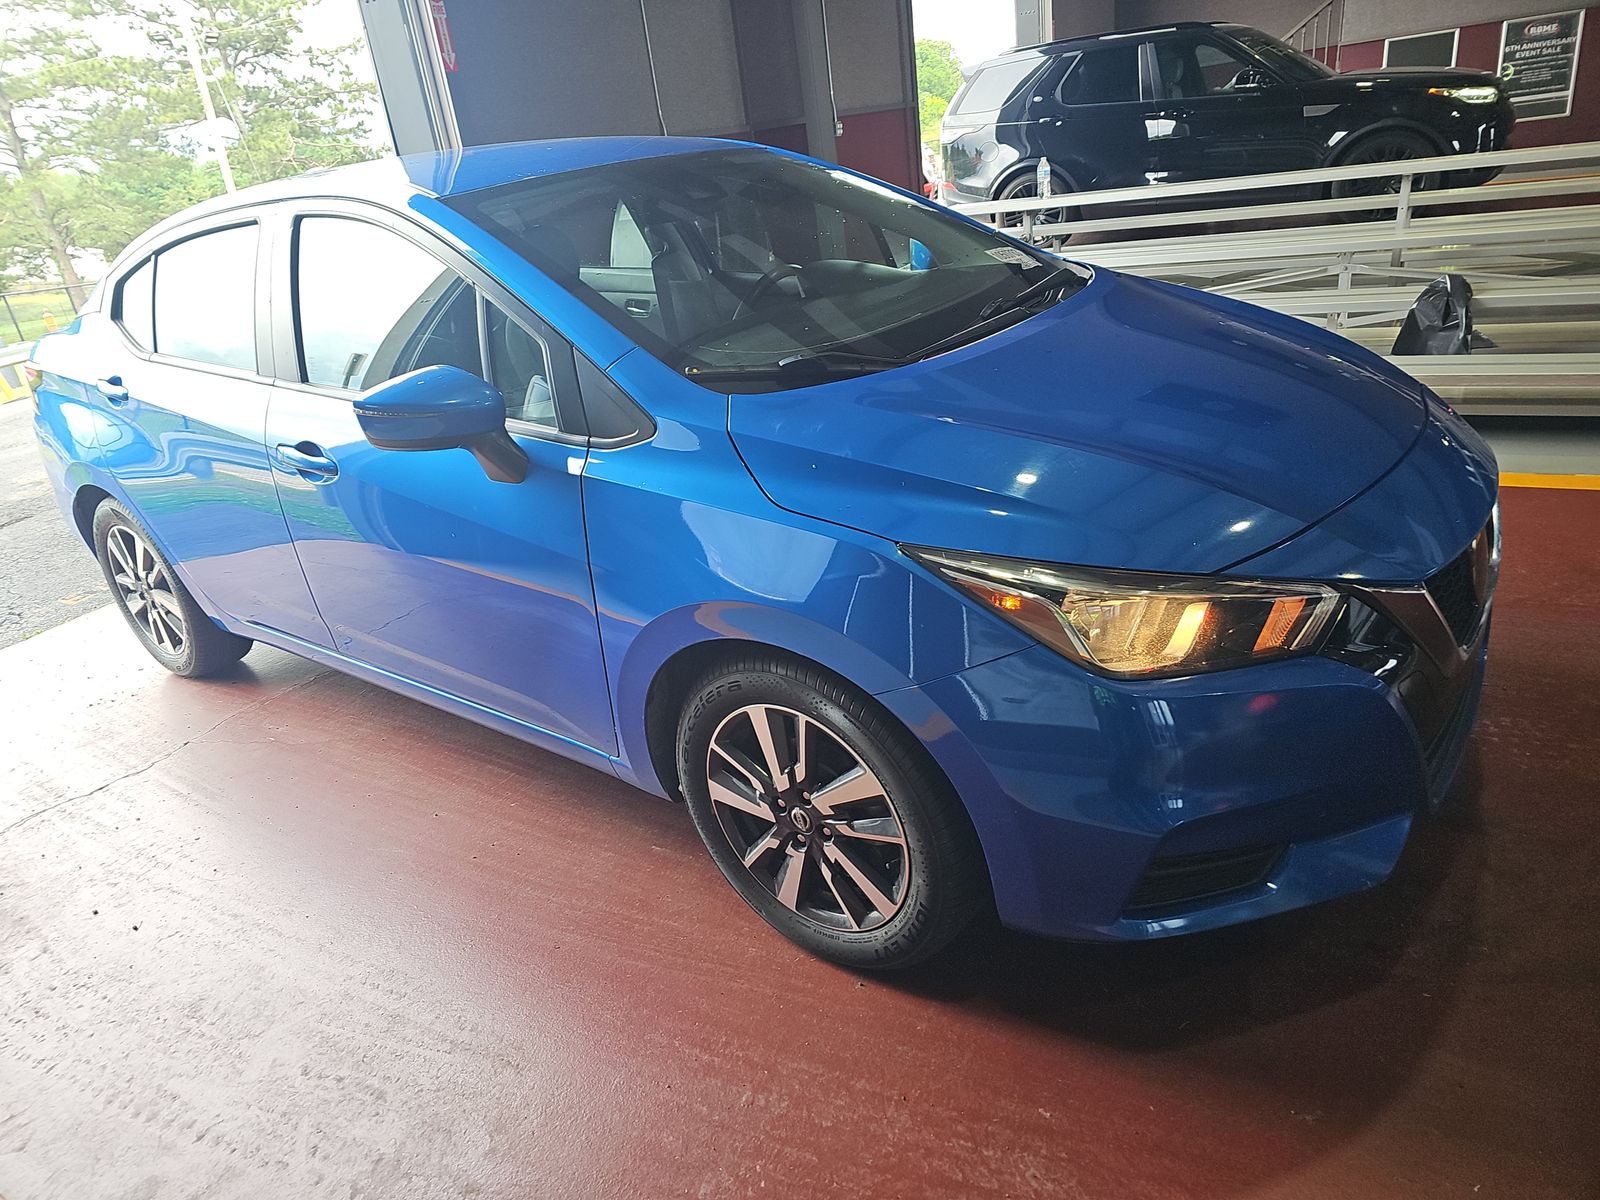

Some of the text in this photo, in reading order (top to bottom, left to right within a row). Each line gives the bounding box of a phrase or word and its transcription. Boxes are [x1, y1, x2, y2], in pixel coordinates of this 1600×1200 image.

[1521, 36, 1577, 50] ANNIVERSARY
[1515, 46, 1562, 58] EVENT SALE
